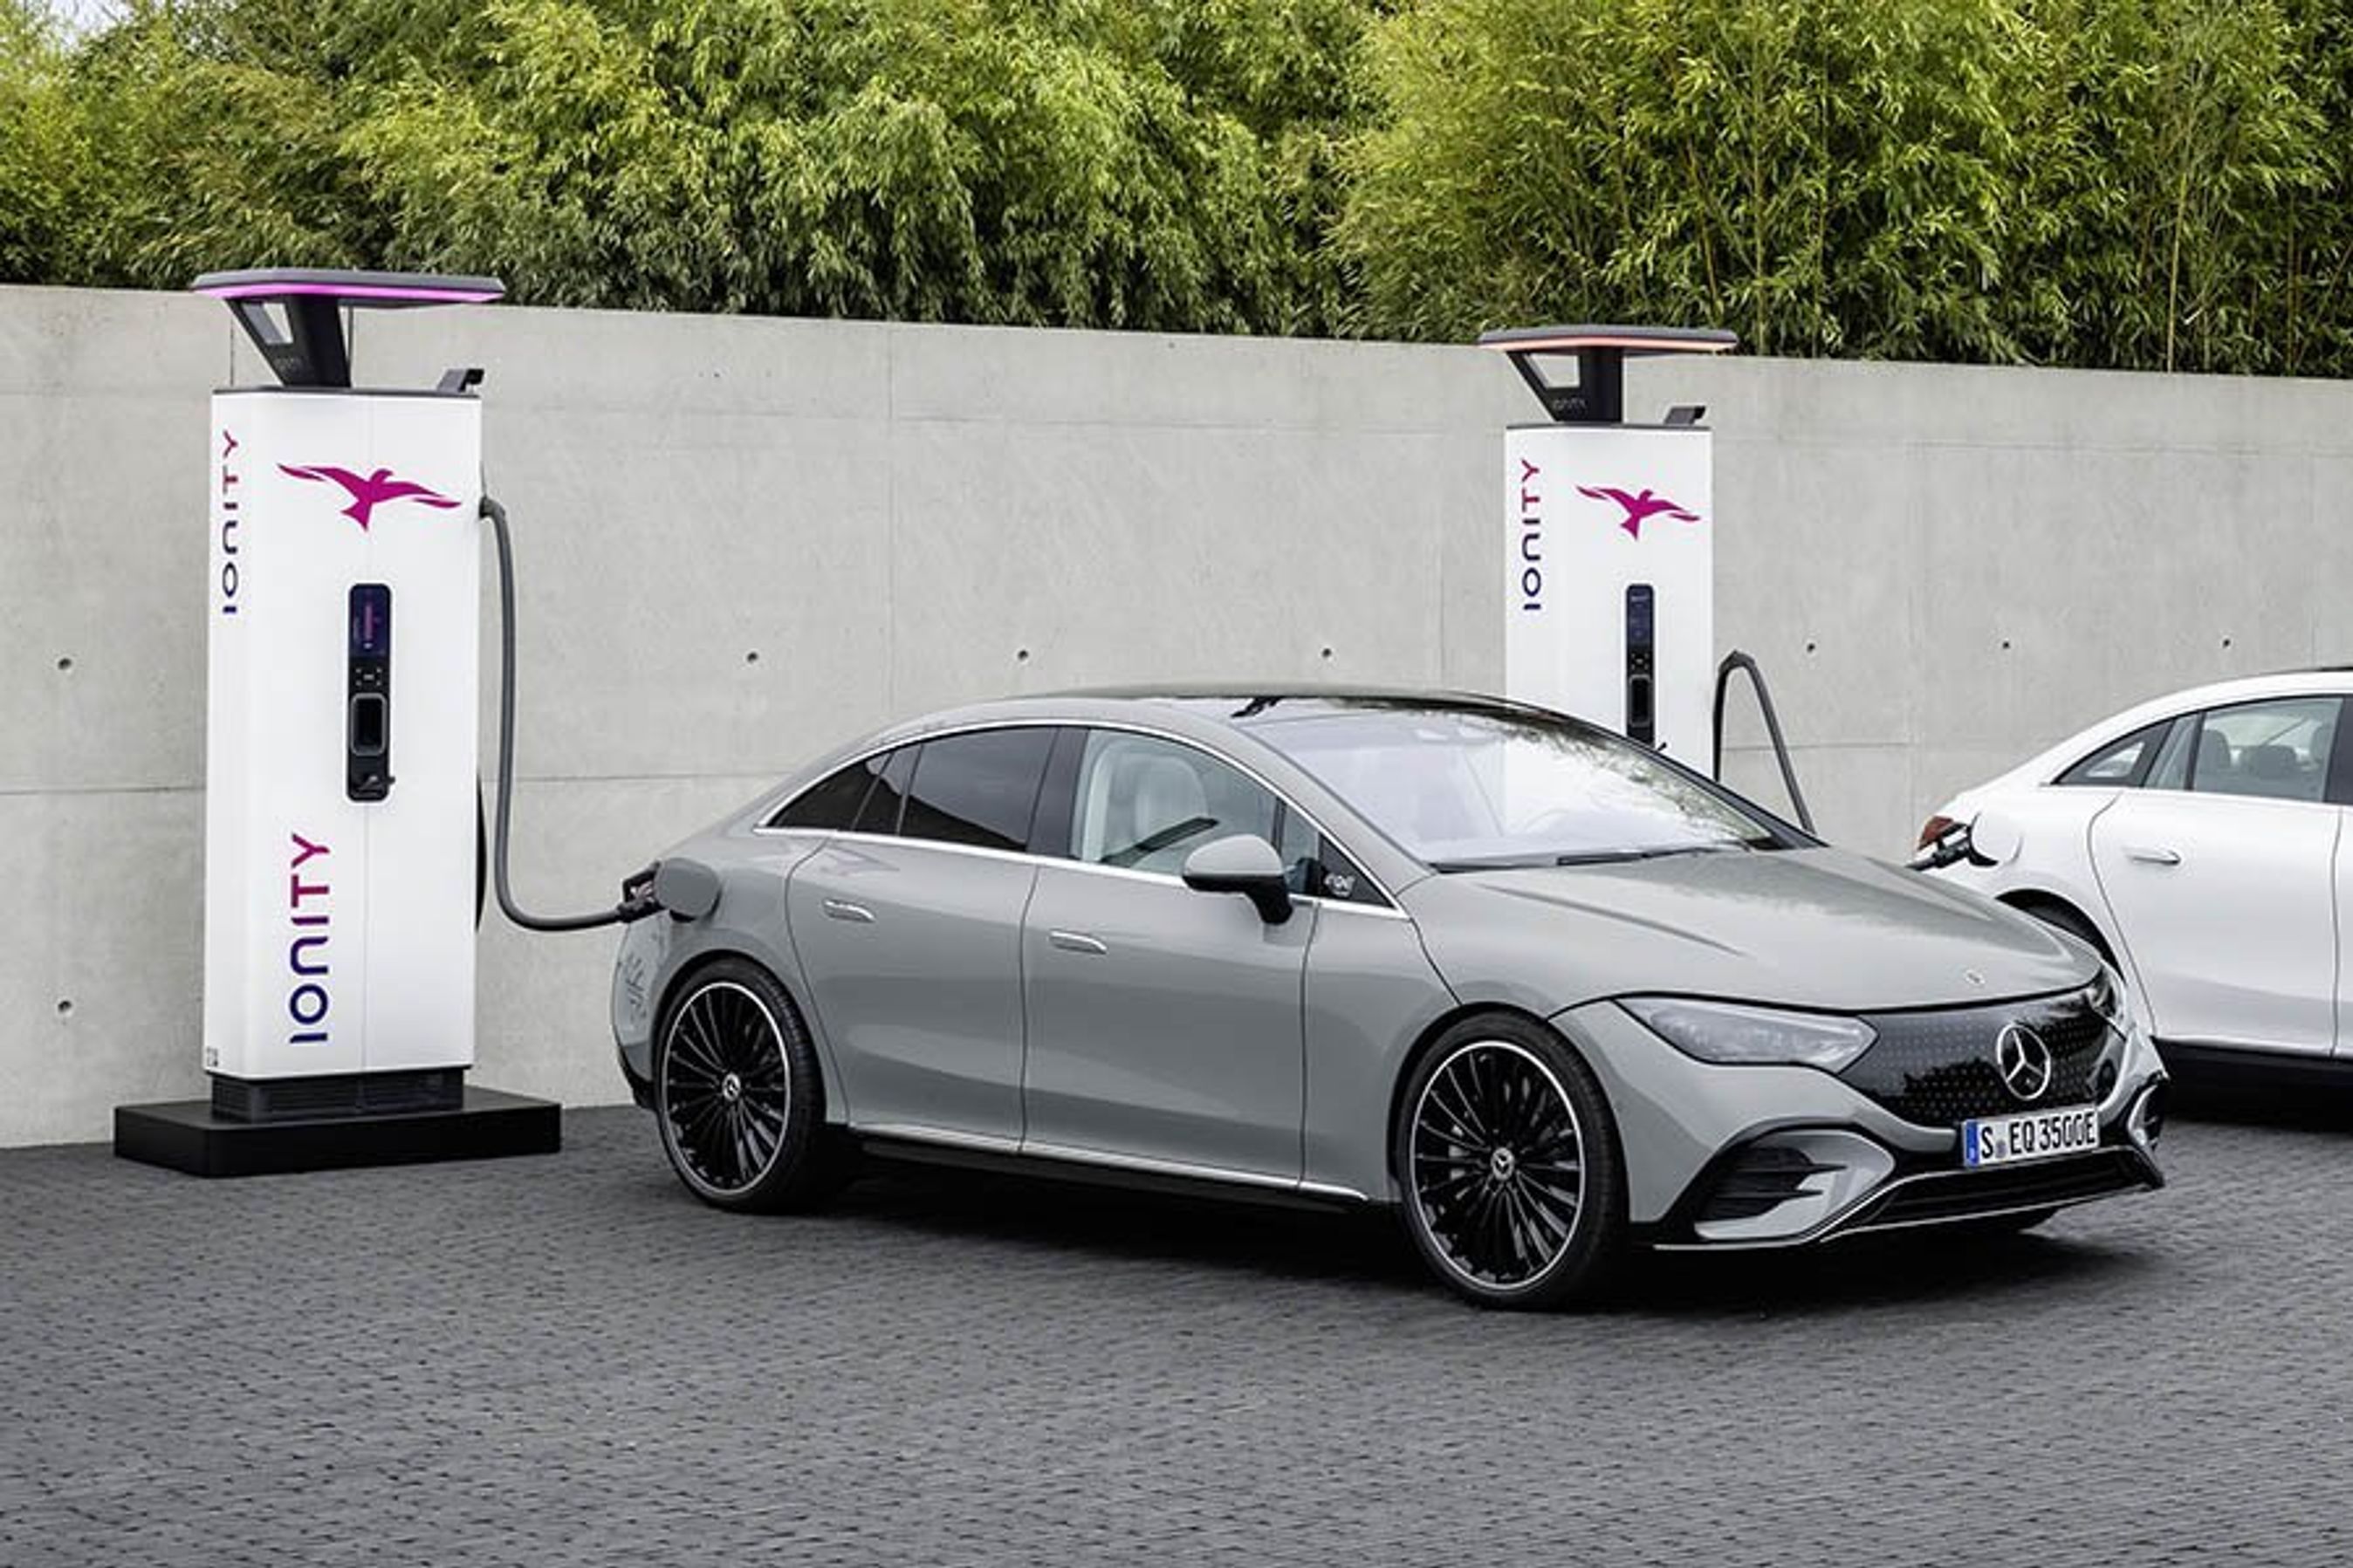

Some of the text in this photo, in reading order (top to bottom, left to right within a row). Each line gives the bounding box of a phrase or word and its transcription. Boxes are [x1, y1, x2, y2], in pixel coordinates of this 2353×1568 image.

[222, 429, 238, 613] IONITY
[1521, 459, 1541, 610] IONITY
[289, 832, 331, 1044] IONITY
